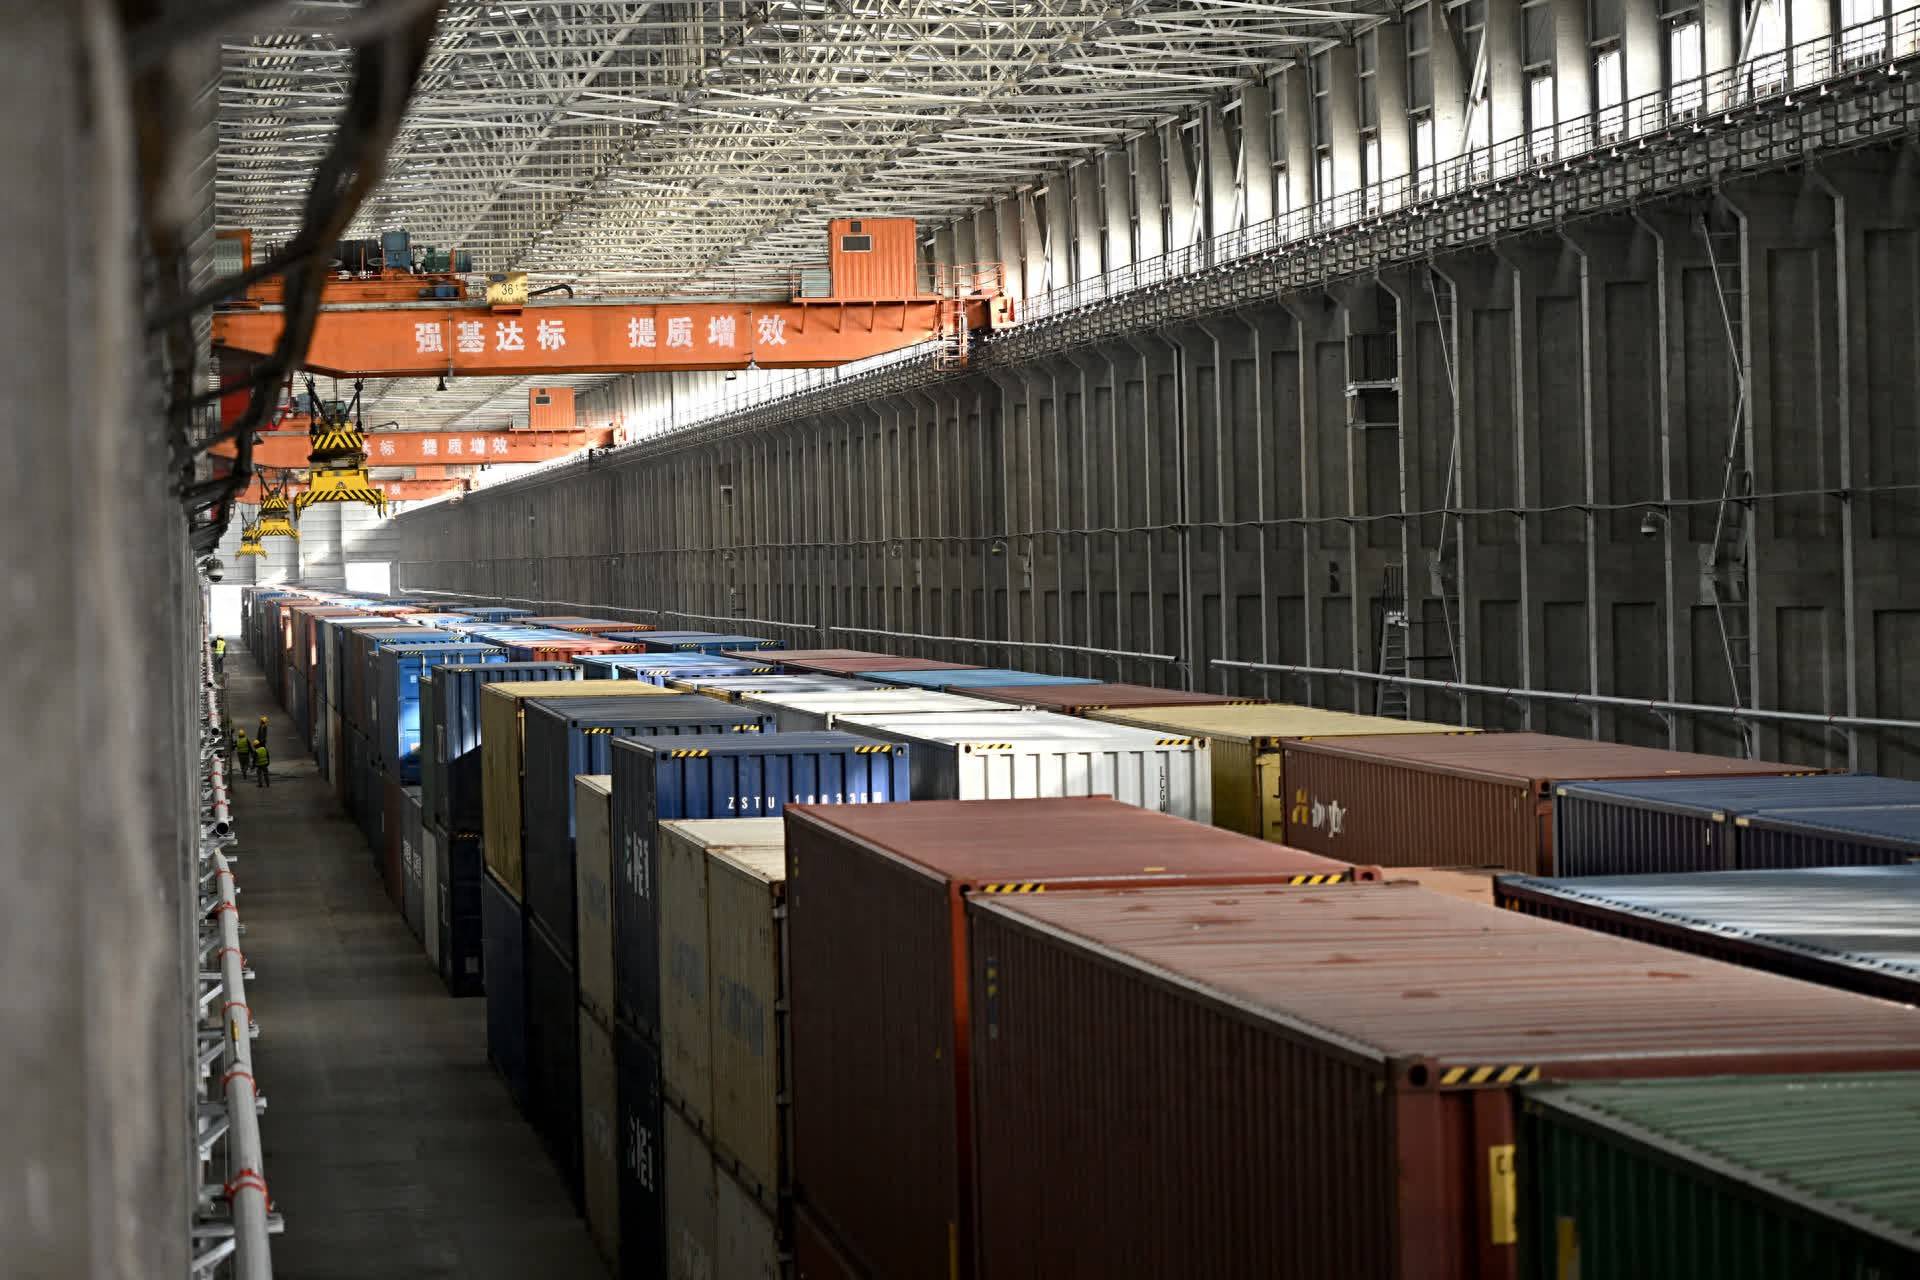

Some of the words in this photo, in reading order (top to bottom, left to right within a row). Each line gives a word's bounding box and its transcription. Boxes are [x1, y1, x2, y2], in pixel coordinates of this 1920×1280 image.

[415, 319, 566, 353] 强基达标
[628, 314, 787, 348] 提质增效
[728, 796, 775, 809] ZSTU
